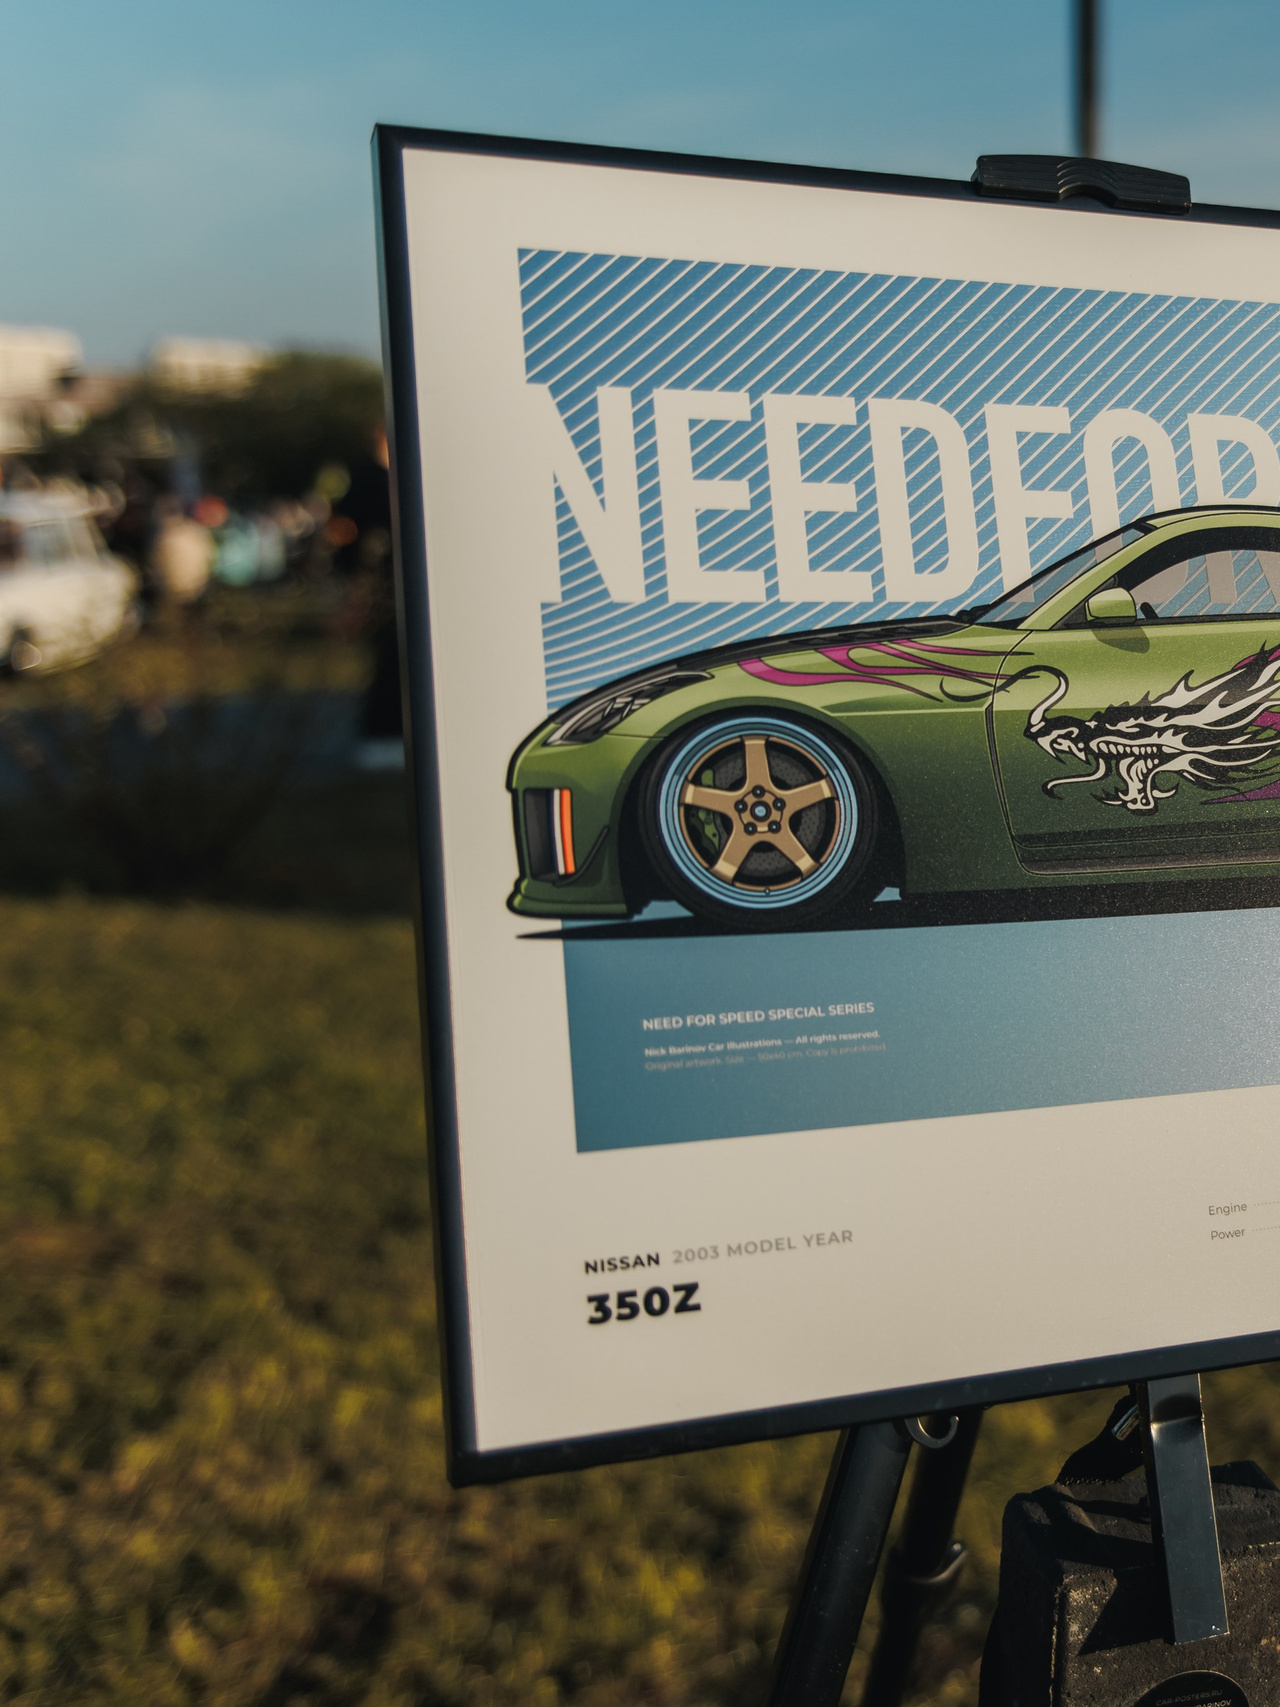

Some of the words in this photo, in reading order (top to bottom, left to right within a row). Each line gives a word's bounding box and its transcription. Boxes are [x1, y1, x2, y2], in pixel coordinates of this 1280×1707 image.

[642, 1016, 683, 1031] NEED
[686, 1013, 716, 1028] FOR
[719, 1010, 765, 1026] SPEED
[768, 1006, 826, 1021] SPECIAL
[828, 1002, 875, 1016] SERIES
[645, 1046, 666, 1057] Nick
[669, 1044, 706, 1055] Barinov
[708, 1042, 724, 1051] Car
[727, 1038, 782, 1050] Illustrations
[795, 1035, 808, 1044] All
[809, 1033, 837, 1045] rights
[839, 1029, 880, 1040] reserved.
[1208, 1202, 1248, 1217] Engine
[1210, 1228, 1245, 1241] Power
[584, 1252, 660, 1275] NISSAN
[672, 1246, 720, 1265] 2003
[726, 1237, 796, 1258] MODEL
[802, 1229, 853, 1249] YEAR
[587, 1281, 701, 1325] 350Z
